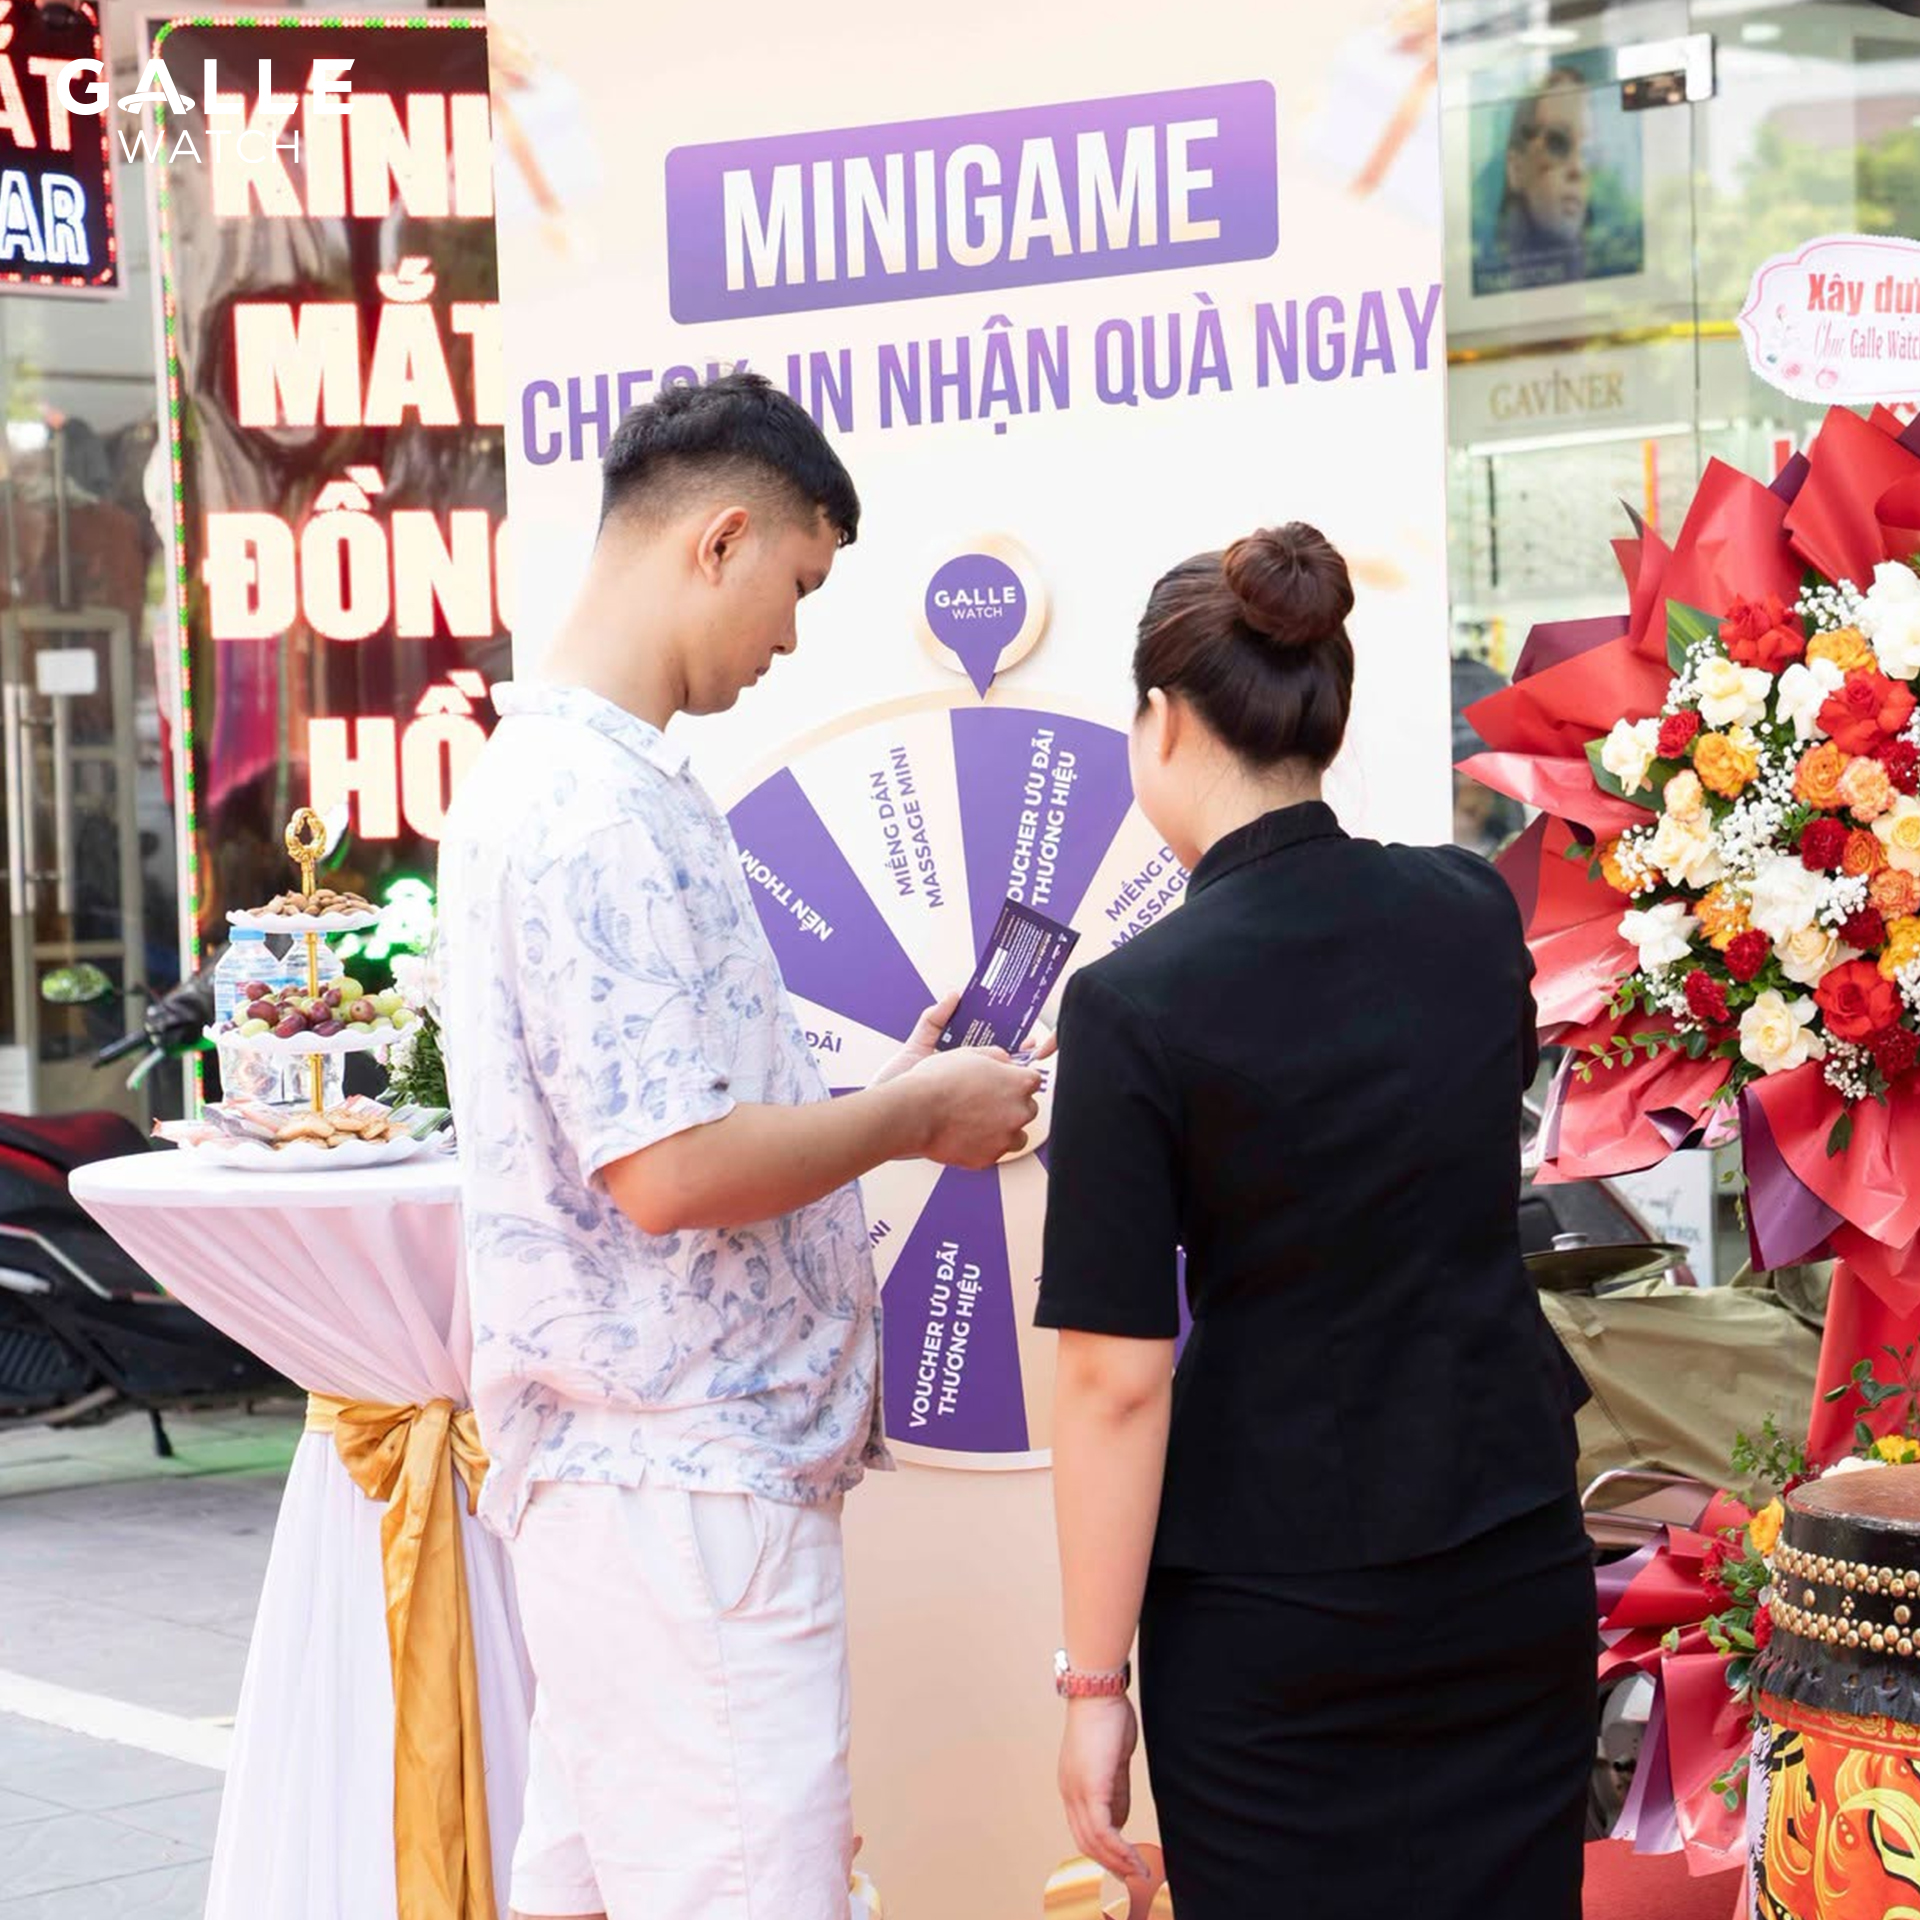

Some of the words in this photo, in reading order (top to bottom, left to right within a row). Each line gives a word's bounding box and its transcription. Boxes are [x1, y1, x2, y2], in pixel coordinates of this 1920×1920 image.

[722, 118, 1221, 292] MINIGAME
[1807, 273, 1864, 316] Xây
[233, 256, 505, 427] MẮT
[878, 313, 1070, 435] NHẬN
[1094, 291, 1233, 407] QUÀ
[1255, 283, 1442, 389] NGAY
[1887, 329, 1920, 361] Watc
[202, 464, 514, 641] ĐỒN
[934, 586, 1017, 608] GALLE
[951, 606, 1003, 620] WATCH
[889, 746, 915, 796] MINI
[1031, 728, 1055, 769] ĐÃI
[869, 771, 895, 819] DÁN
[1023, 771, 1046, 806] ƯU
[903, 799, 944, 908] MASSAGE
[1006, 809, 1039, 903] OUCHER
[1031, 809, 1065, 906] THƯƠNG
[1050, 751, 1078, 806] HIỆU
[1111, 866, 1192, 949] MASSAGE
[936, 1241, 959, 1281] ĐÃI
[930, 1284, 950, 1317] ƯU
[938, 1321, 970, 1415] THƯƠNG
[956, 1263, 983, 1317] HIỆU
[909, 1321, 945, 1427] VOUCHER
